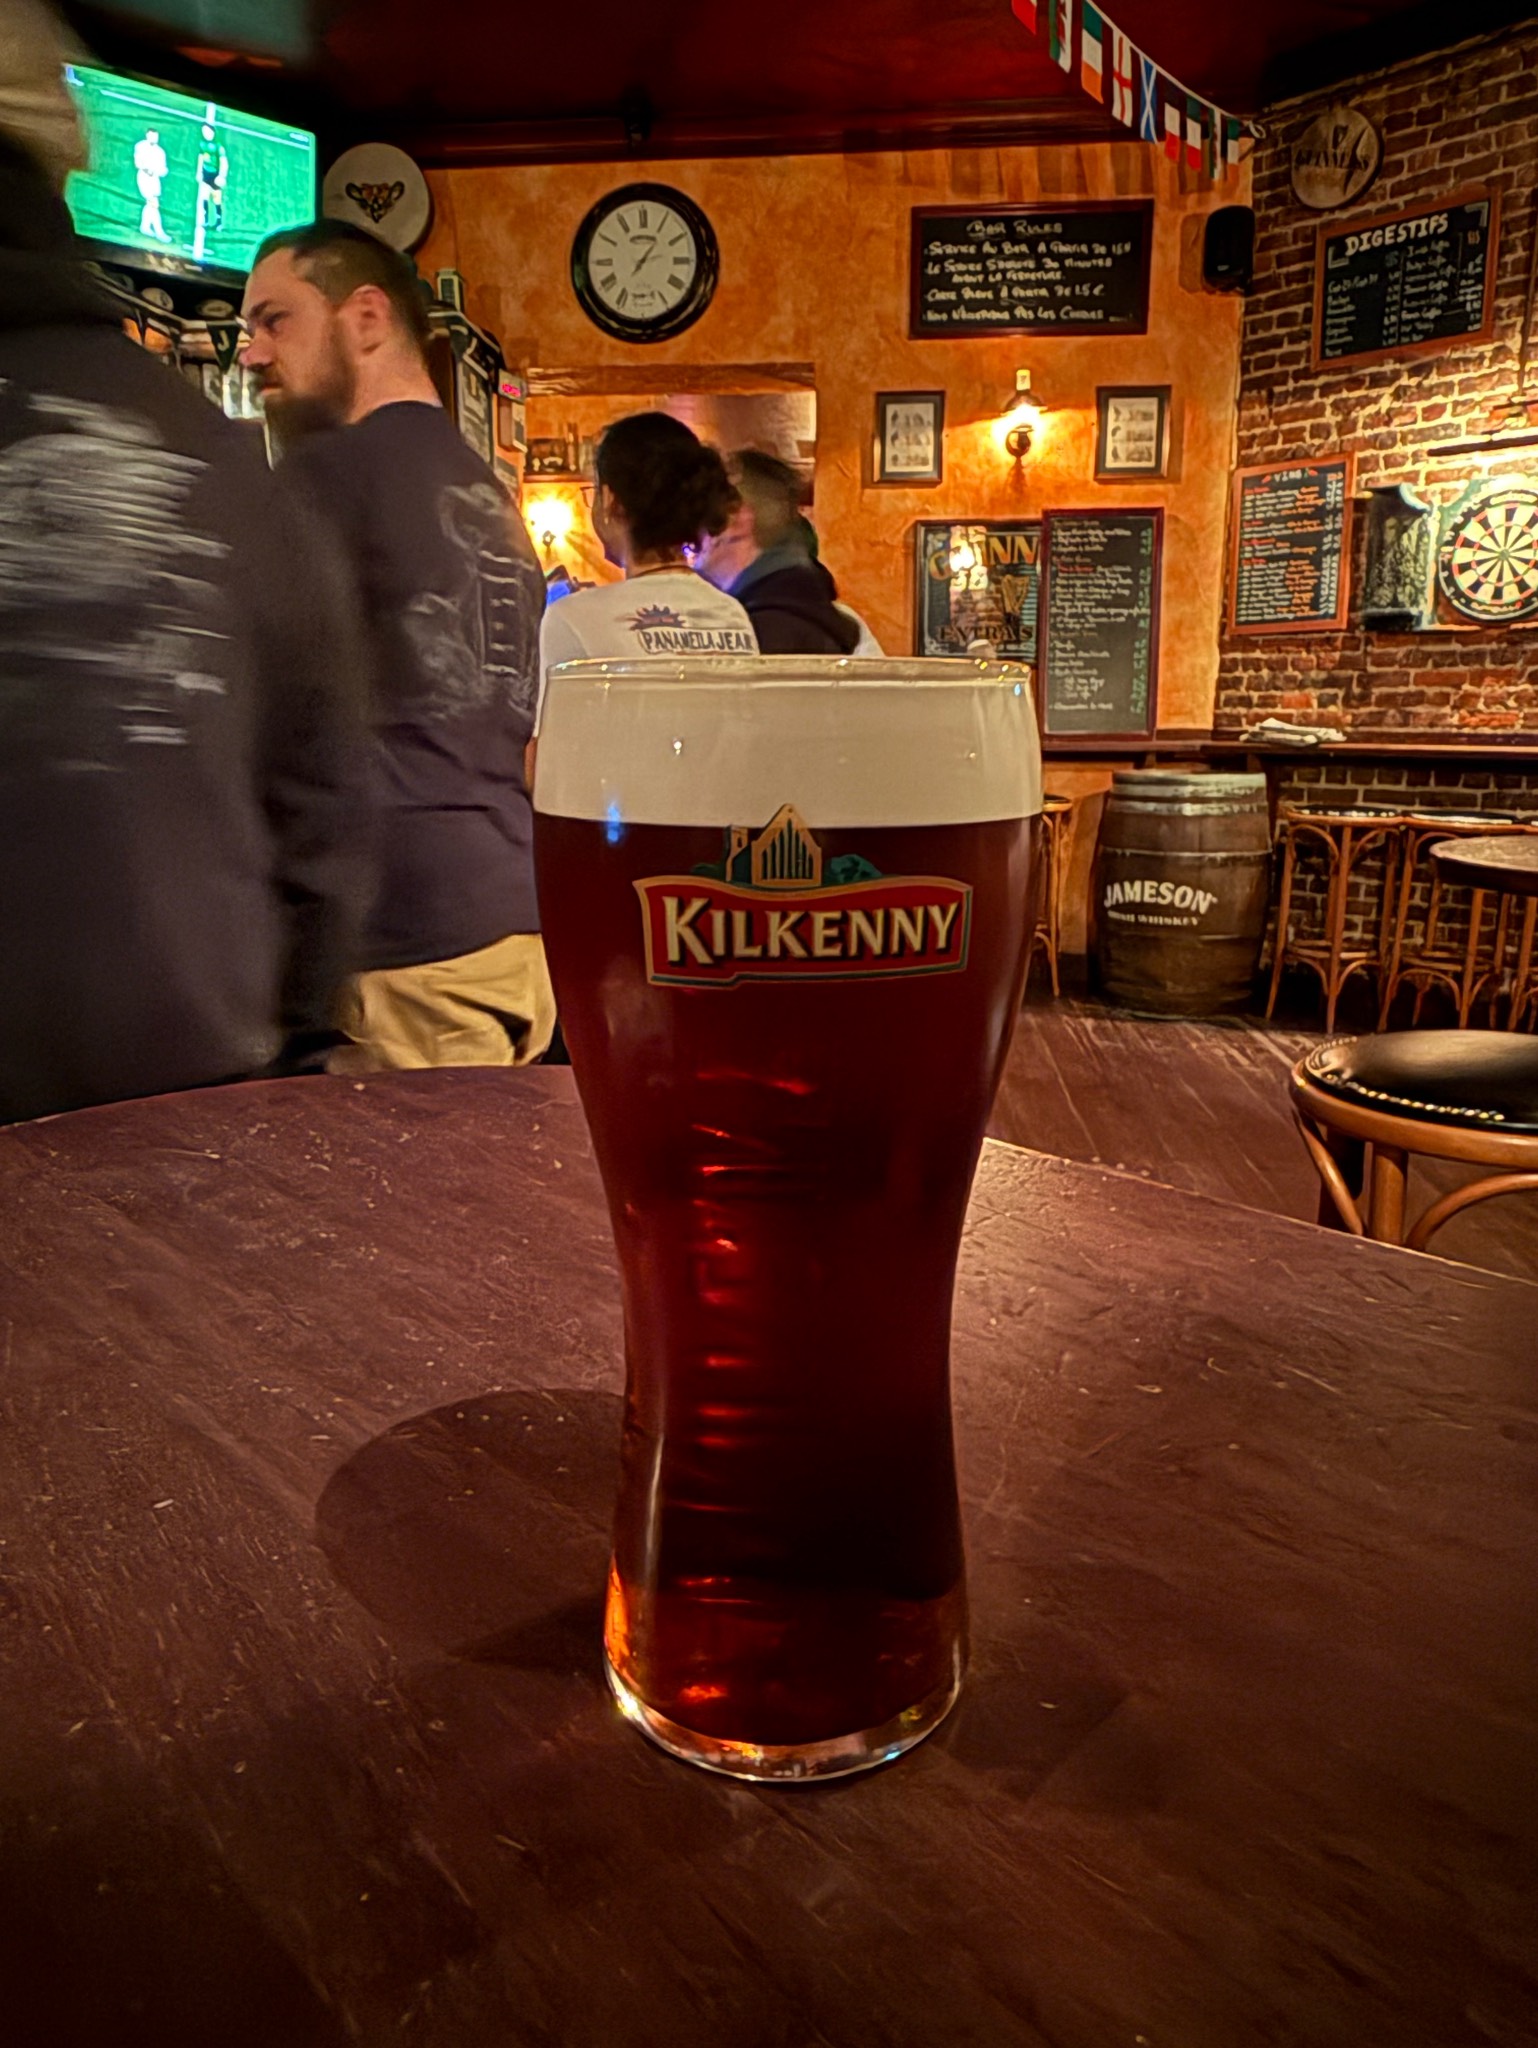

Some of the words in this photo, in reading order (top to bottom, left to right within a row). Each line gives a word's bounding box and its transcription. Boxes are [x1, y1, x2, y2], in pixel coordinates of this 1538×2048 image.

[1345, 213, 1448, 256] DIGESTIFS
[1103, 880, 1213, 915] JAMESON
[662, 895, 960, 965] KILKENNY
